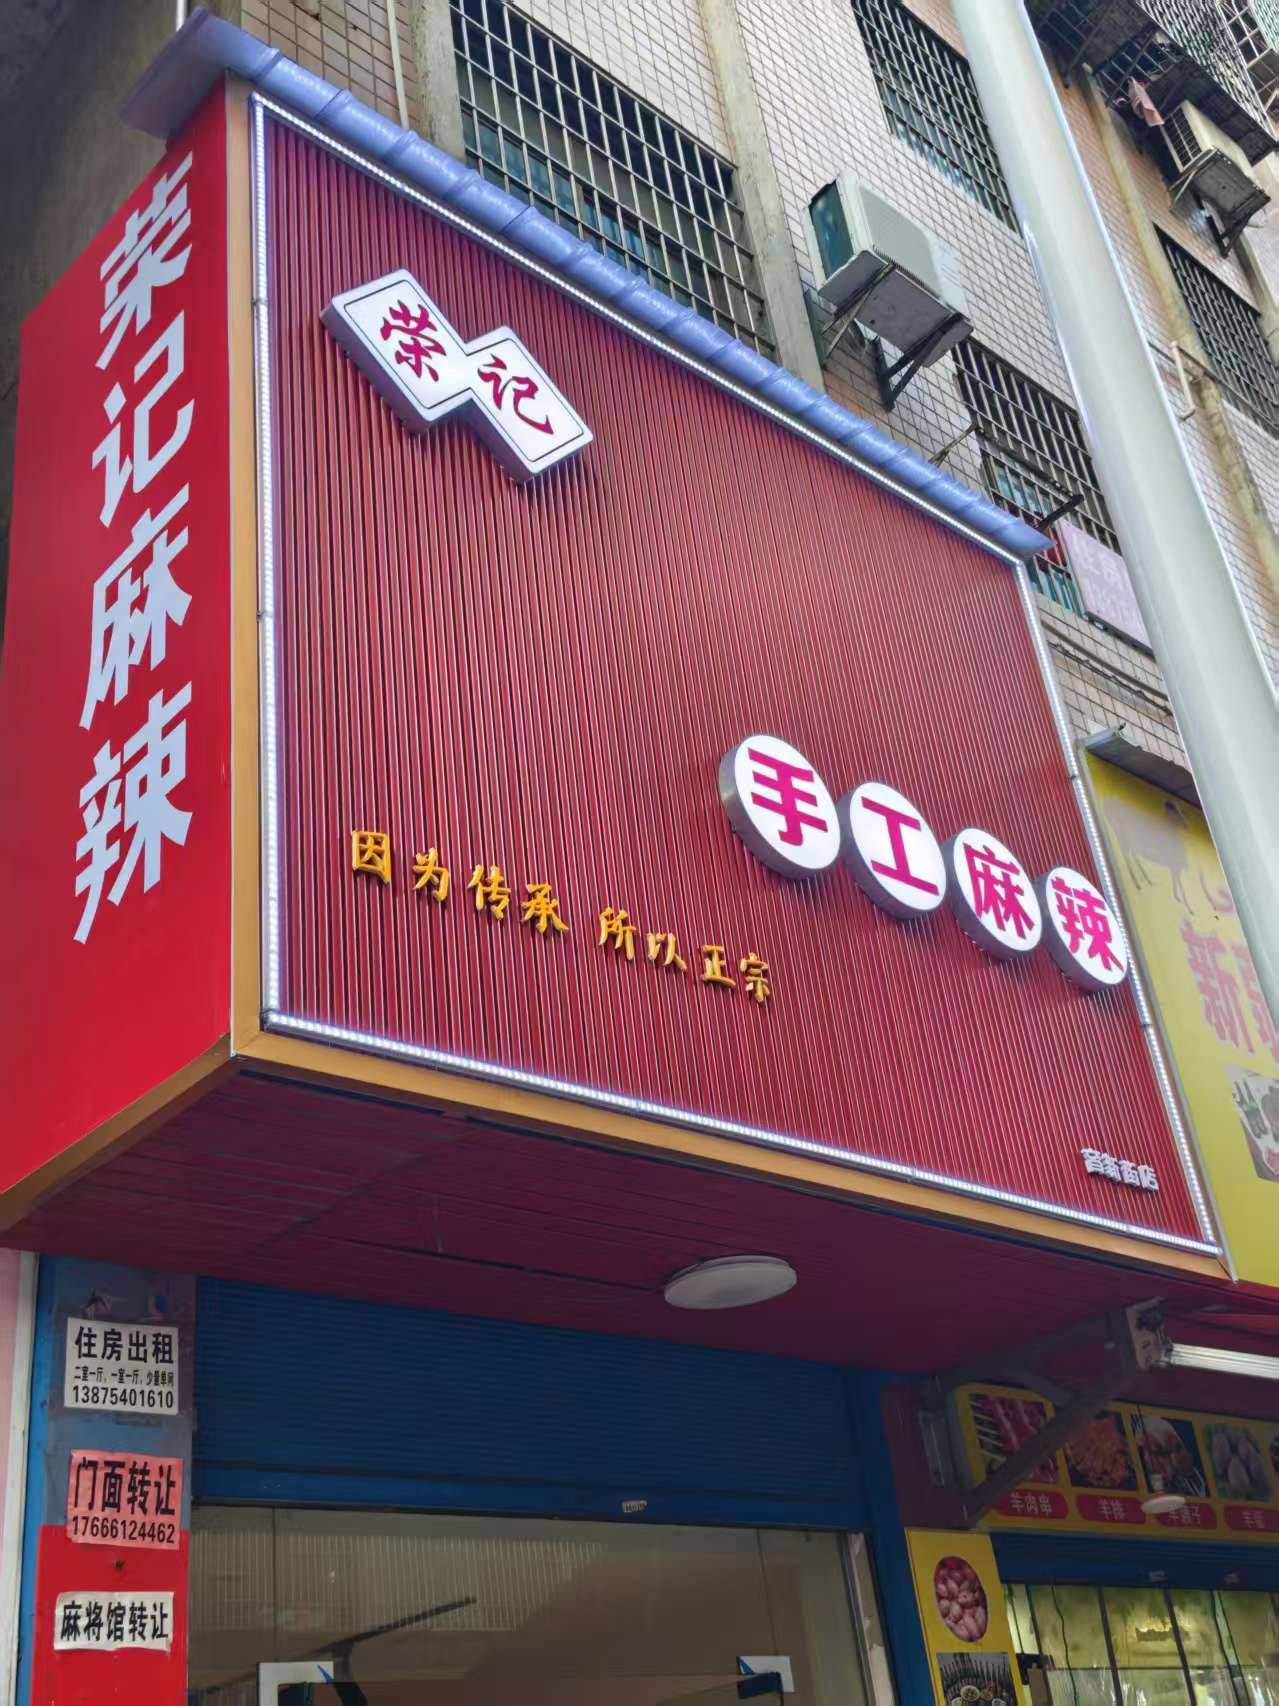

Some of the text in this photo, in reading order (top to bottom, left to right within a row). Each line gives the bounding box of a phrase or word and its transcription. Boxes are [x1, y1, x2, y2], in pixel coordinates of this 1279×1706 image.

[380, 299, 555, 436] 荣记
[72, 151, 195, 944] 荣记麻辣
[748, 747, 1125, 973] 手工麻辣
[352, 830, 771, 1004] 因为传承 所以正宗
[74, 1326, 174, 1364] 住房出租
[72, 1385, 174, 1409] 13875401610
[73, 1457, 176, 1515] 门面转让
[1010, 1493, 1052, 1516] 羊肉串
[72, 1516, 175, 1544] 17666124462
[60, 1600, 169, 1642] 麻将馆转让
